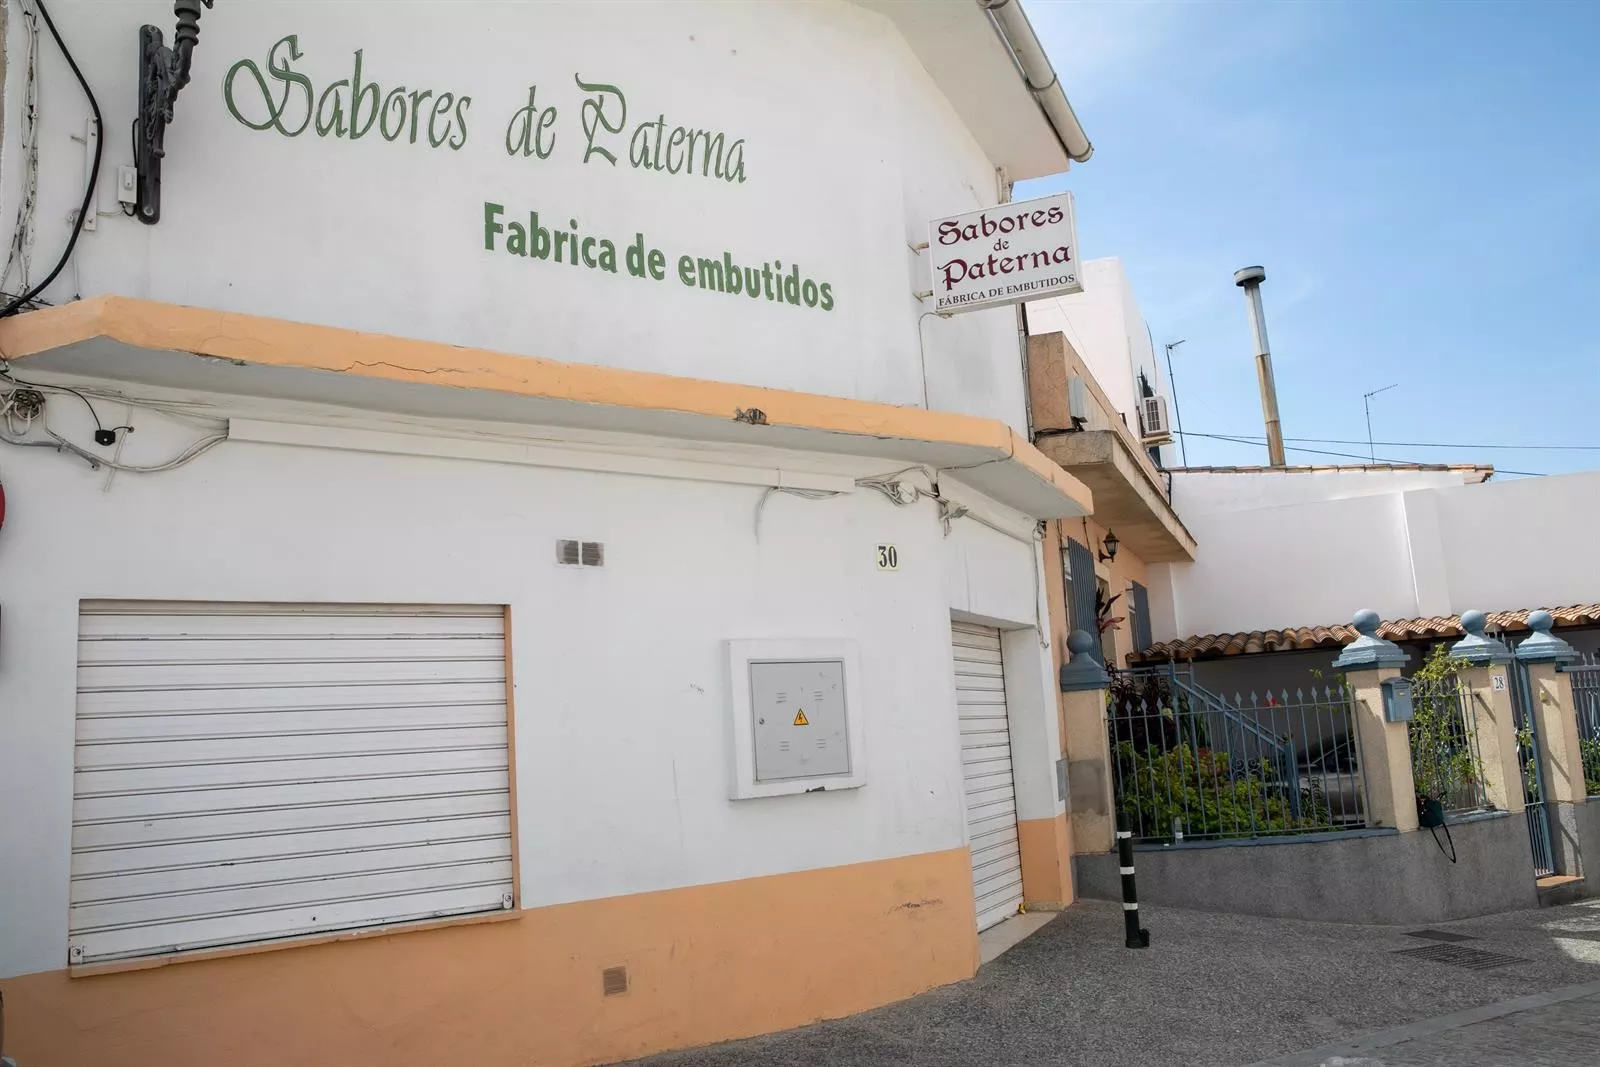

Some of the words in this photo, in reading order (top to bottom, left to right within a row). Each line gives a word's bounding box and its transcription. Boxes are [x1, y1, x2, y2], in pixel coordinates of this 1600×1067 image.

[223, 34, 472, 151] Sabores
[505, 85, 557, 160] de
[575, 72, 748, 183] Paterna
[938, 206, 1064, 245] Sabores
[484, 201, 618, 274] Fabrica
[624, 232, 666, 281] de
[678, 251, 835, 312] embutidos
[993, 238, 1010, 252] de
[937, 246, 1071, 291] Paterna
[938, 291, 986, 307] FÁBRICA
[989, 288, 1004, 297] DE
[1007, 274, 1075, 294] EMBUTIDOS
[878, 545, 898, 568] 30
[1494, 676, 1505, 689] 28
